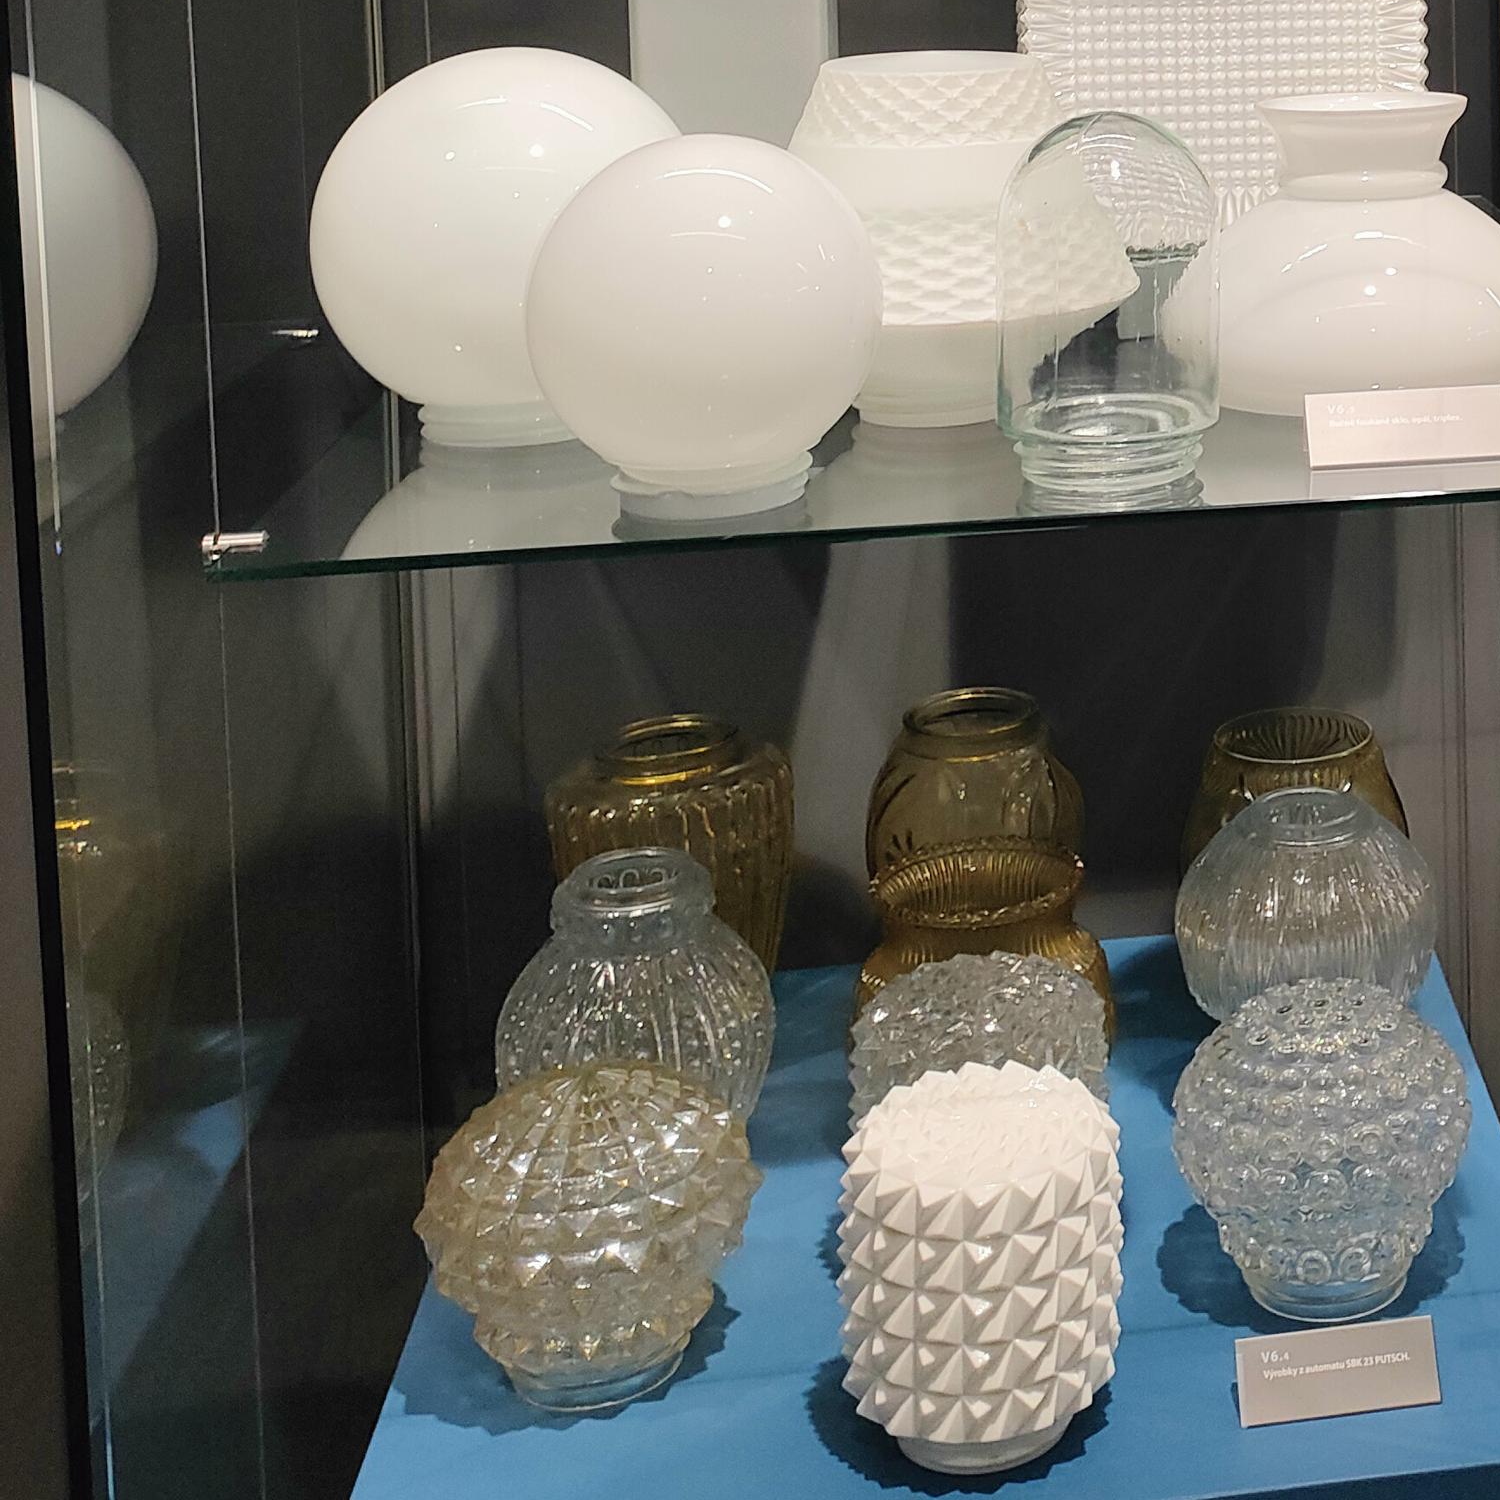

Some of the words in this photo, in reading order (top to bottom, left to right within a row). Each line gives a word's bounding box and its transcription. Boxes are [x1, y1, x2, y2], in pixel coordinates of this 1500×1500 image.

[1263, 1366, 1298, 1381] Výrobky
[1305, 1362, 1345, 1375] automatu
[1363, 1356, 1374, 1367] 23
